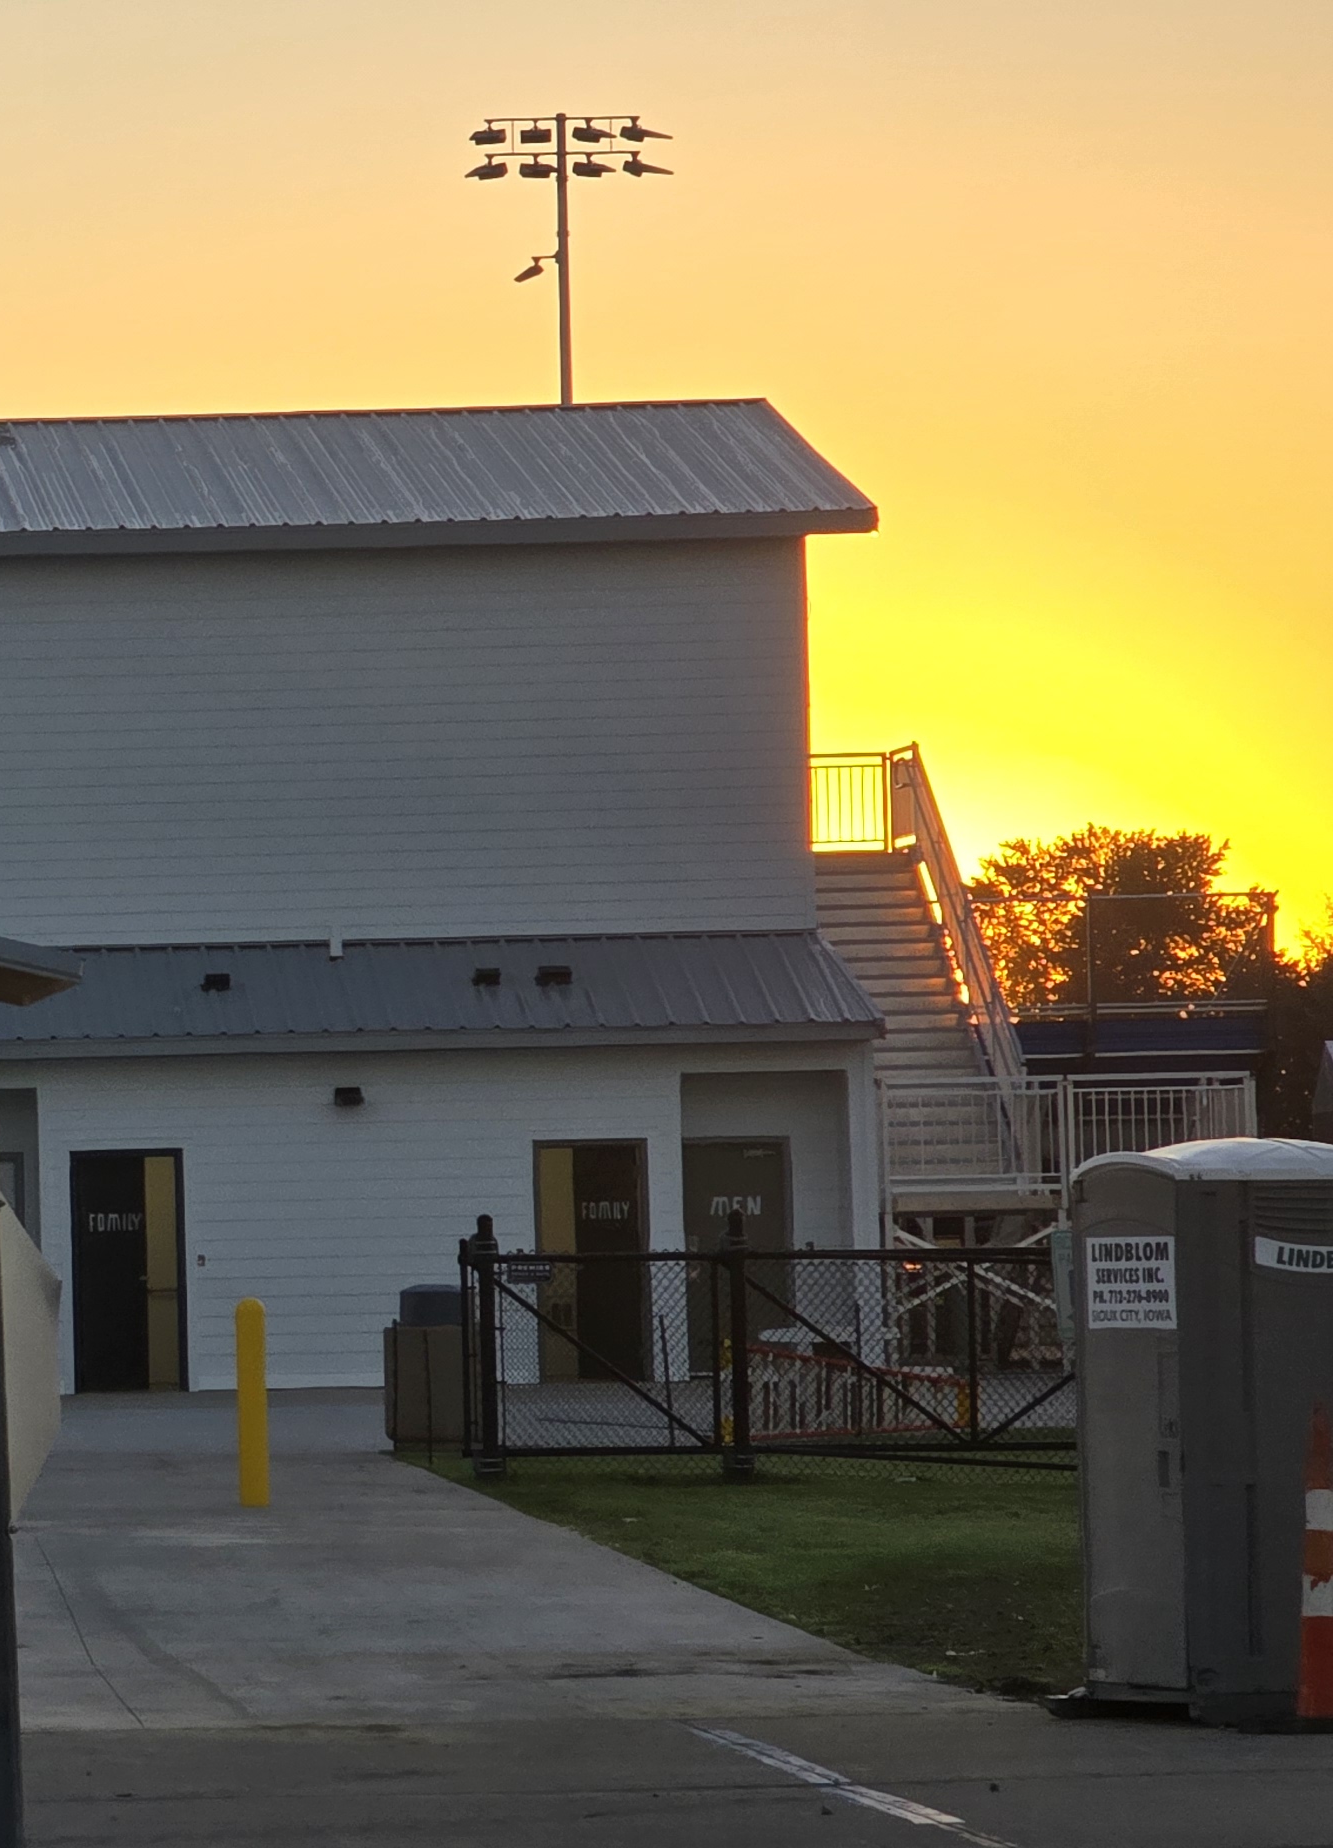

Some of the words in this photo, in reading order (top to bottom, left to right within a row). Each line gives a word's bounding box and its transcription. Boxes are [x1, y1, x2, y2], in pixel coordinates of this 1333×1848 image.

[1092, 1242, 1169, 1262] LINDBLOM
[1096, 1267, 1140, 1284] SERVICES
[1143, 1266, 1165, 1283] INC.
[1092, 1309, 1118, 1322] SIOUX
[1120, 1309, 1141, 1324] CITY,
[1144, 1308, 1172, 1321] IOWA
